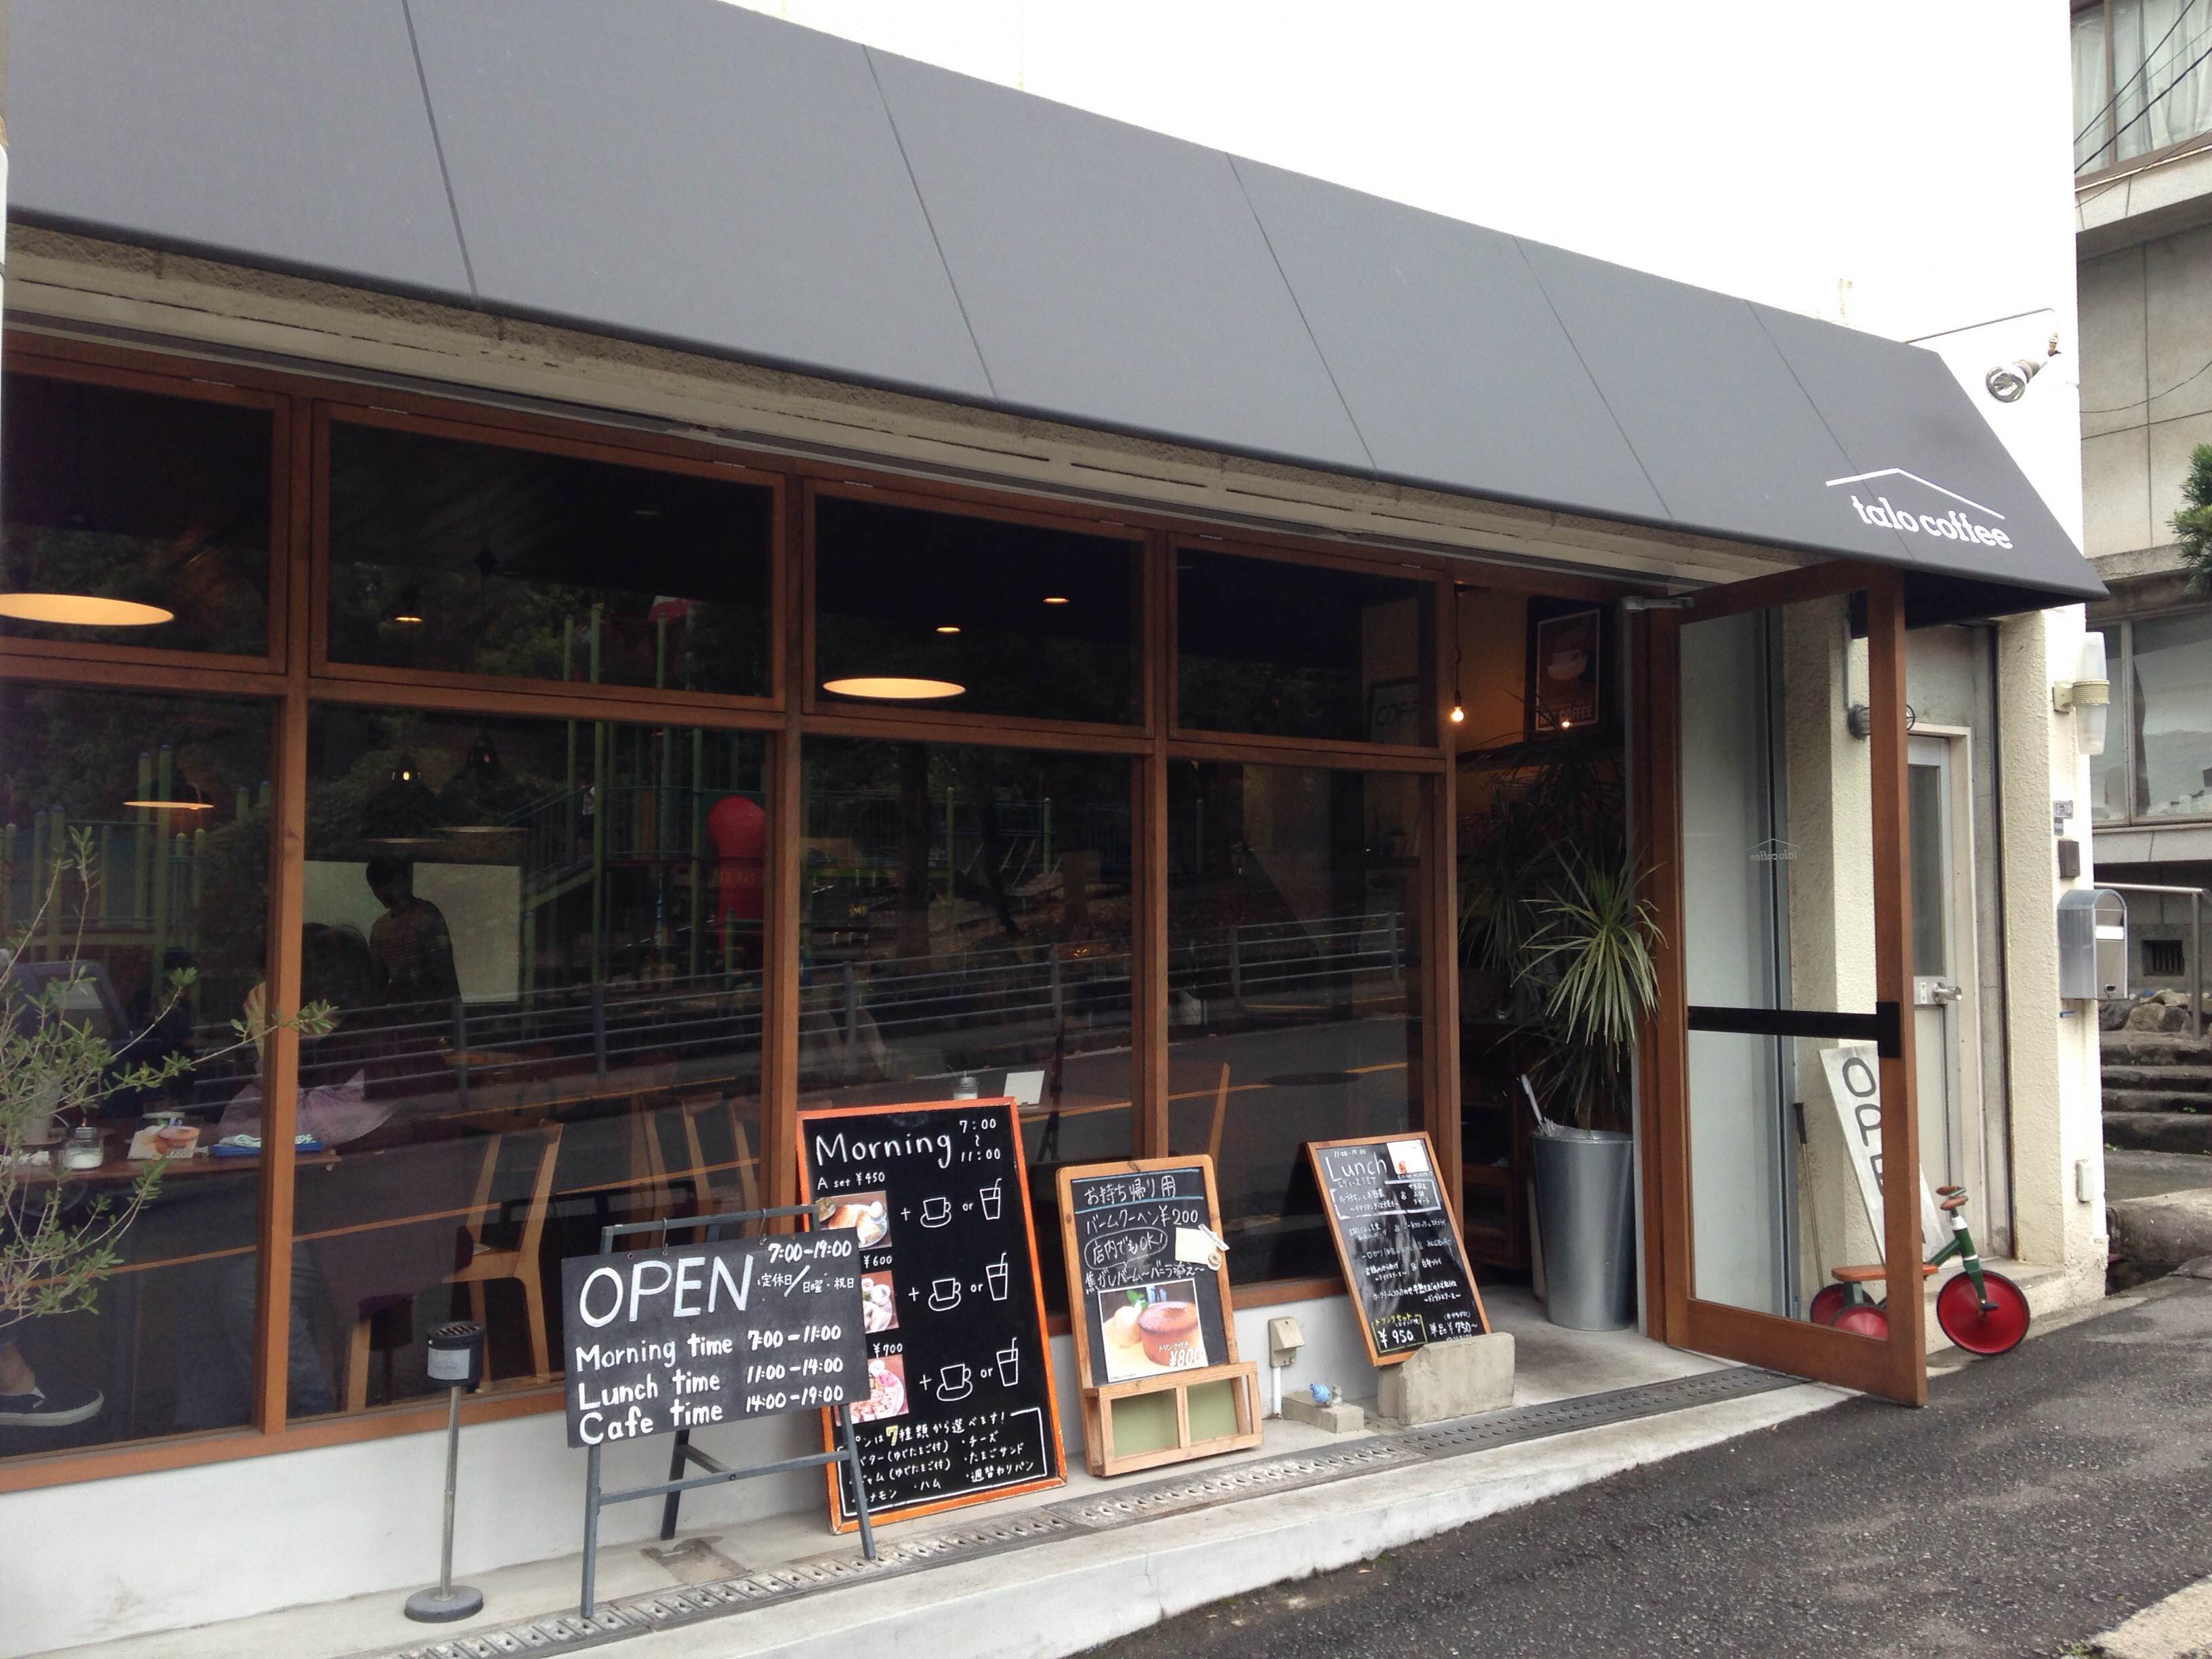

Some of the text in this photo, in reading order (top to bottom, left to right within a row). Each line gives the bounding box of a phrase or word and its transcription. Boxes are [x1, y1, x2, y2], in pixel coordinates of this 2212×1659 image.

[1851, 495, 2013, 550] talo coffee
[959, 1118, 997, 1134] 7:00
[816, 1132, 951, 1169] Morning
[960, 1149, 1001, 1163] 11:00
[1326, 1151, 1387, 1182] Lunch
[817, 1172, 886, 1191] A set ¥450
[1084, 1175, 1176, 1205] お持ち帰り用
[962, 1201, 974, 1212] or
[863, 1255, 893, 1269] ¥600
[579, 1254, 754, 1328] OPEN
[970, 1282, 983, 1293] or
[575, 1338, 676, 1372] Morning
[687, 1332, 733, 1357] time
[980, 1367, 994, 1378] or
[579, 1374, 658, 1411] Lunch
[672, 1368, 721, 1395] time
[579, 1408, 654, 1445] Cafe
[670, 1398, 723, 1427] time
[869, 1489, 897, 1503] ナモン
